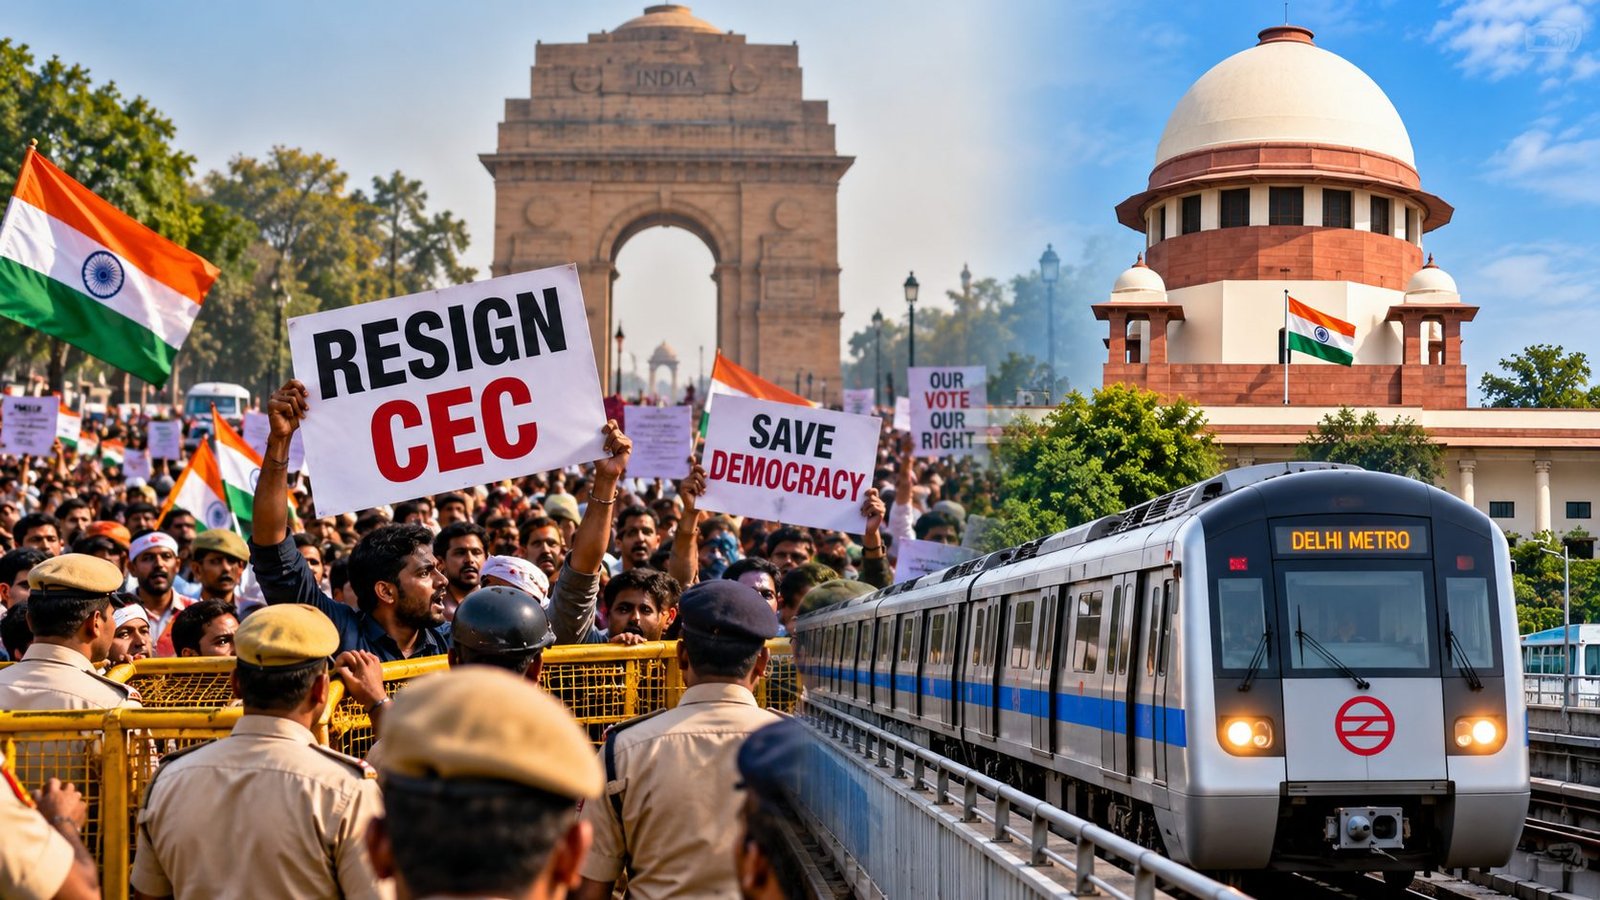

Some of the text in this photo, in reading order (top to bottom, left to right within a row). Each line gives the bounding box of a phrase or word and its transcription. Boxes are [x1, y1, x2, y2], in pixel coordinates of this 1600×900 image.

[636, 69, 697, 88] INDIA
[313, 286, 568, 401] RESIGN
[929, 371, 965, 389] OUR
[924, 391, 971, 409] VOTE
[370, 376, 539, 483] CEC
[930, 411, 966, 430] OUR
[749, 414, 836, 460] SAVE
[921, 431, 976, 450] RIGHT
[709, 449, 866, 502] DEMOCRACY
[1291, 531, 1411, 550] DELHI METRO
